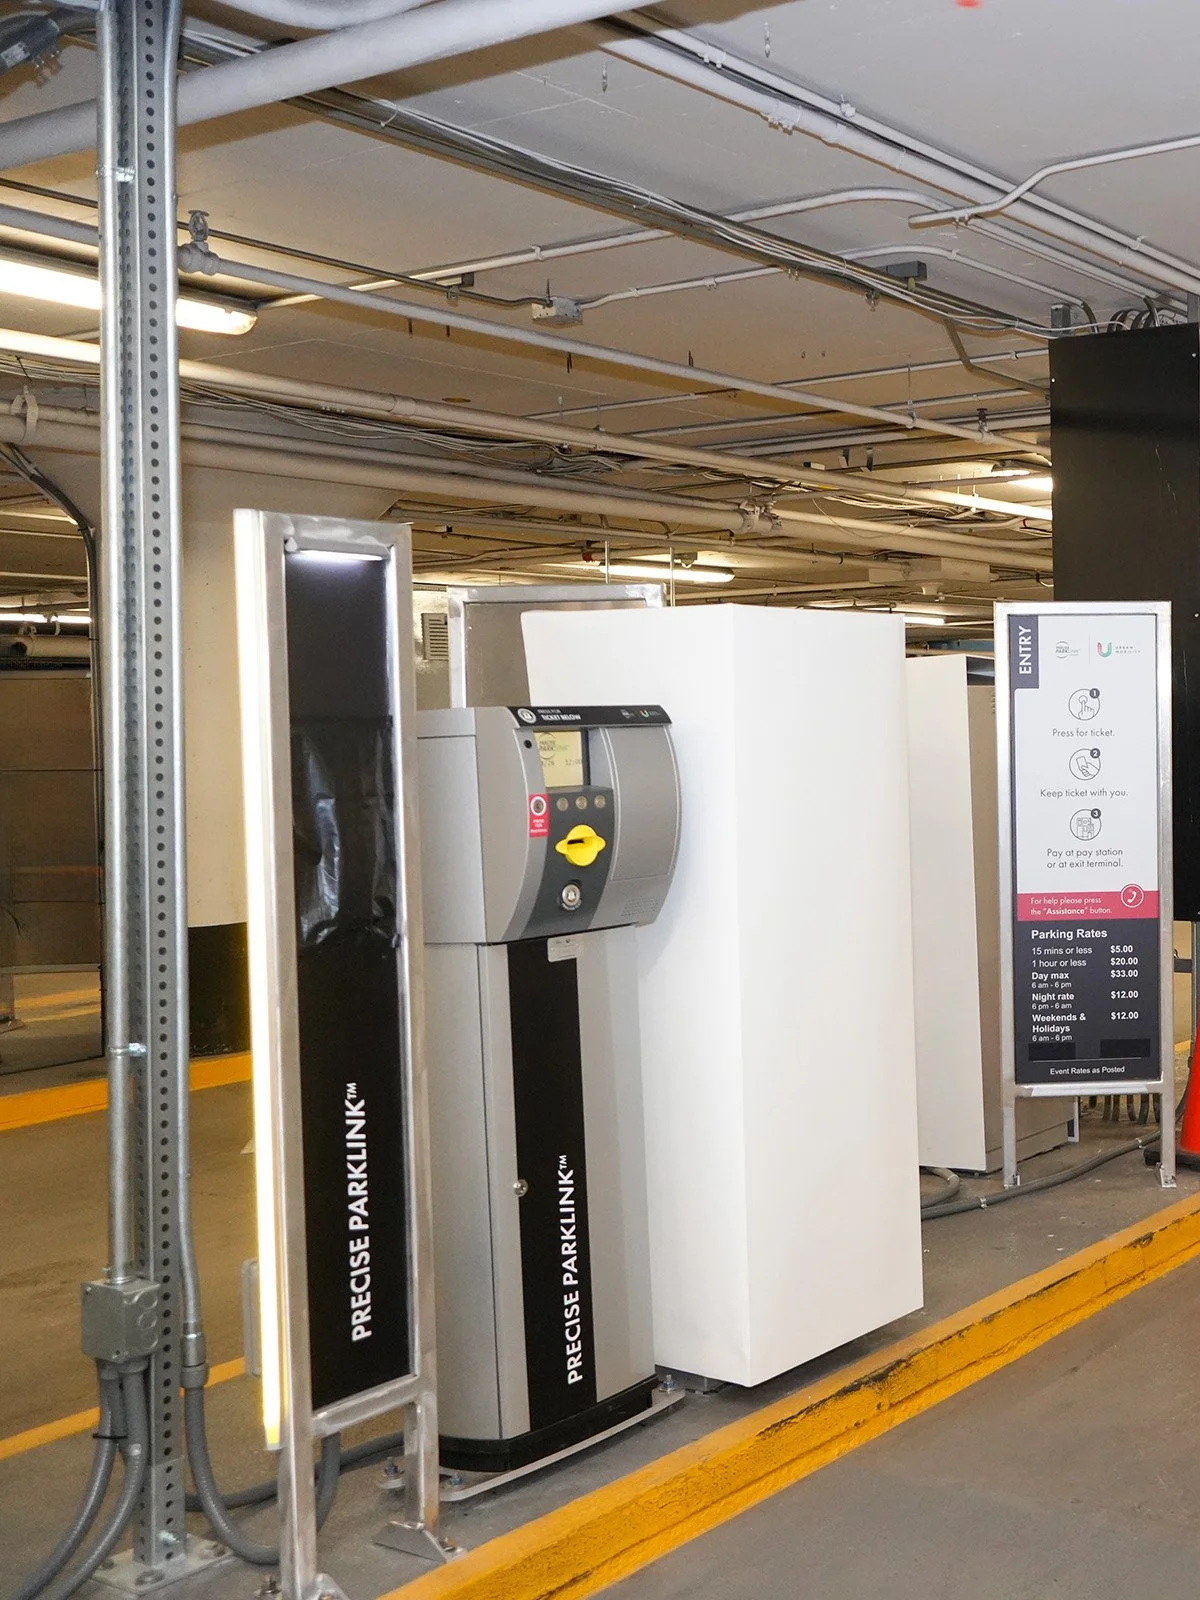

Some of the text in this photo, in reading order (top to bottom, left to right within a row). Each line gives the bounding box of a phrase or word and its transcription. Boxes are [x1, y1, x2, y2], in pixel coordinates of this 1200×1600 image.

[1019, 626, 1032, 674] ENTRY
[1052, 728, 1115, 737] Press for ticket.
[1040, 788, 1128, 798] Keep ticket with you.
[1047, 848, 1123, 858] Pay at pay station
[1070, 860, 1085, 868] exit
[1086, 859, 1124, 868] terminal.
[1044, 897, 1058, 906] help
[1060, 897, 1083, 906] please
[1031, 929, 1108, 940] Parking Rates
[1044, 947, 1064, 955] mins
[1076, 946, 1093, 954] less
[1111, 945, 1133, 954] $5.00
[1032, 960, 1036, 968] 1
[1039, 959, 1058, 967] hour
[1070, 959, 1087, 967] less
[1111, 957, 1139, 966] $20.00
[1032, 972, 1070, 981] Day max
[1111, 970, 1139, 978] $33.00
[1032, 993, 1056, 1002] Night
[1111, 991, 1139, 1000] $12.00
[1032, 1013, 1086, 1022] Weekends &
[1111, 1012, 1139, 1020] $12.00
[1032, 1025, 1071, 1034] Holidays
[1102, 1066, 1125, 1074] Posted
[349, 1236, 372, 1342] PRECISE
[563, 1291, 583, 1385] PRECISE
